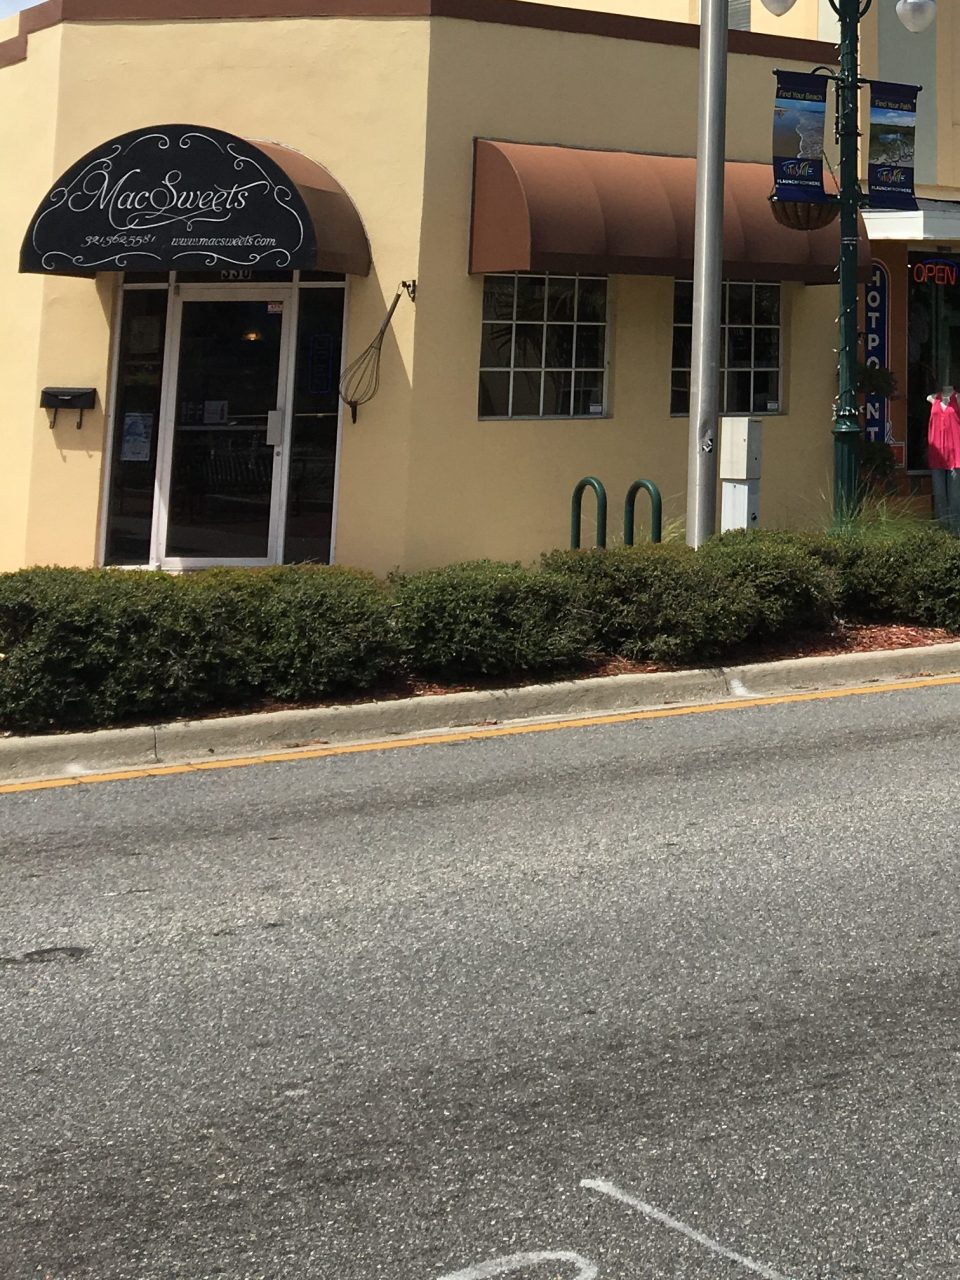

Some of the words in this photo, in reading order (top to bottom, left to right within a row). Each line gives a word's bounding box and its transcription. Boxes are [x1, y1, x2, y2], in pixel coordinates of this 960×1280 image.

[779, 89, 791, 98] Find
[792, 91, 804, 99] Your
[805, 92, 823, 101] Beach
[875, 99, 888, 108] Find
[889, 101, 900, 109] Your
[900, 102, 912, 111] Path
[68, 169, 270, 231] MacSweets
[913, 263, 957, 285] OPEN
[866, 271, 881, 442] HOTPONT
